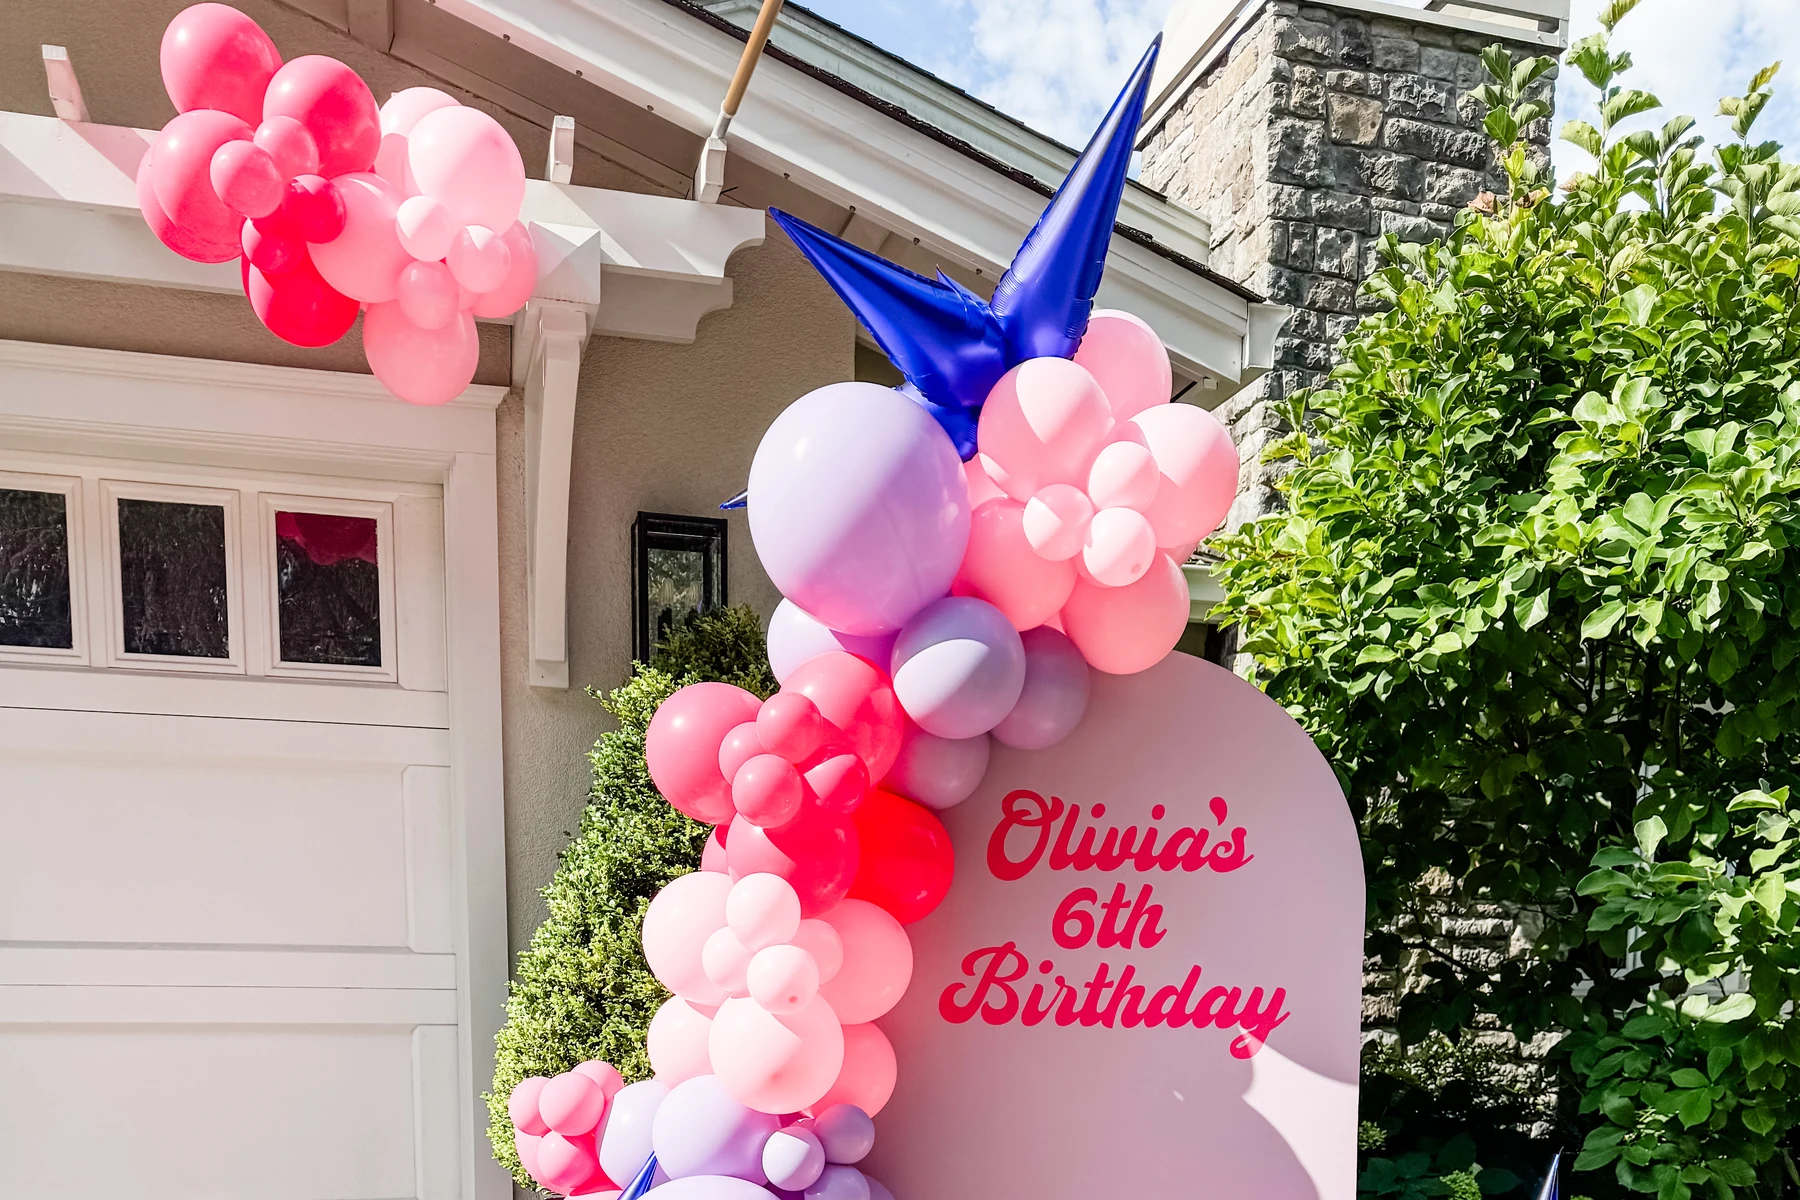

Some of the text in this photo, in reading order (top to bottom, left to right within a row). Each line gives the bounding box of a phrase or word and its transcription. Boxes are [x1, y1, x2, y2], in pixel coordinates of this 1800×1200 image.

[986, 789, 1255, 881] Olivia's
[1051, 882, 1168, 950] 6th
[938, 941, 1291, 1060] Birthday
